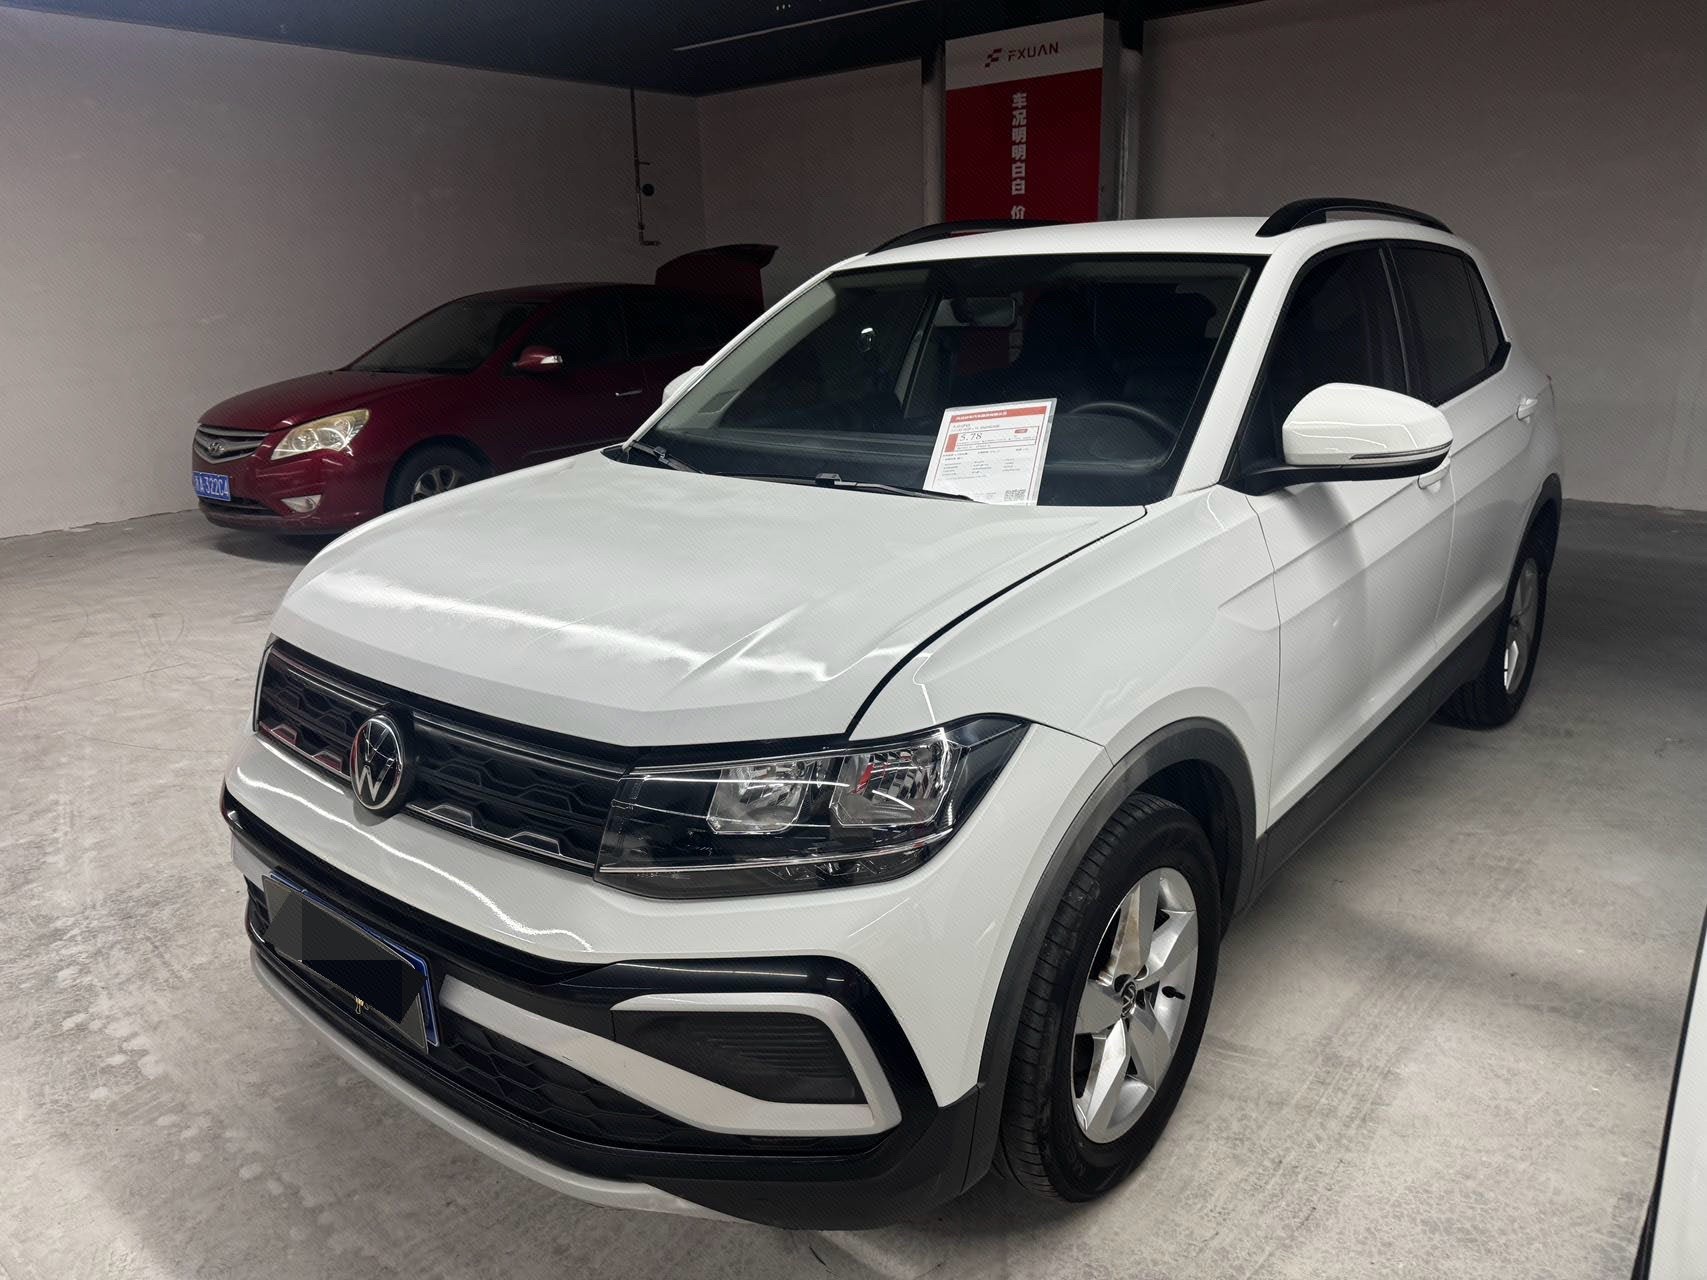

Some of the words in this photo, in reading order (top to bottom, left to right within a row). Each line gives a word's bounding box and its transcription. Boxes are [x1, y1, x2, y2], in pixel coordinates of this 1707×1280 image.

[1008, 42, 1059, 62] FXUAN
[1012, 92, 1027, 195] 车况明明白白
